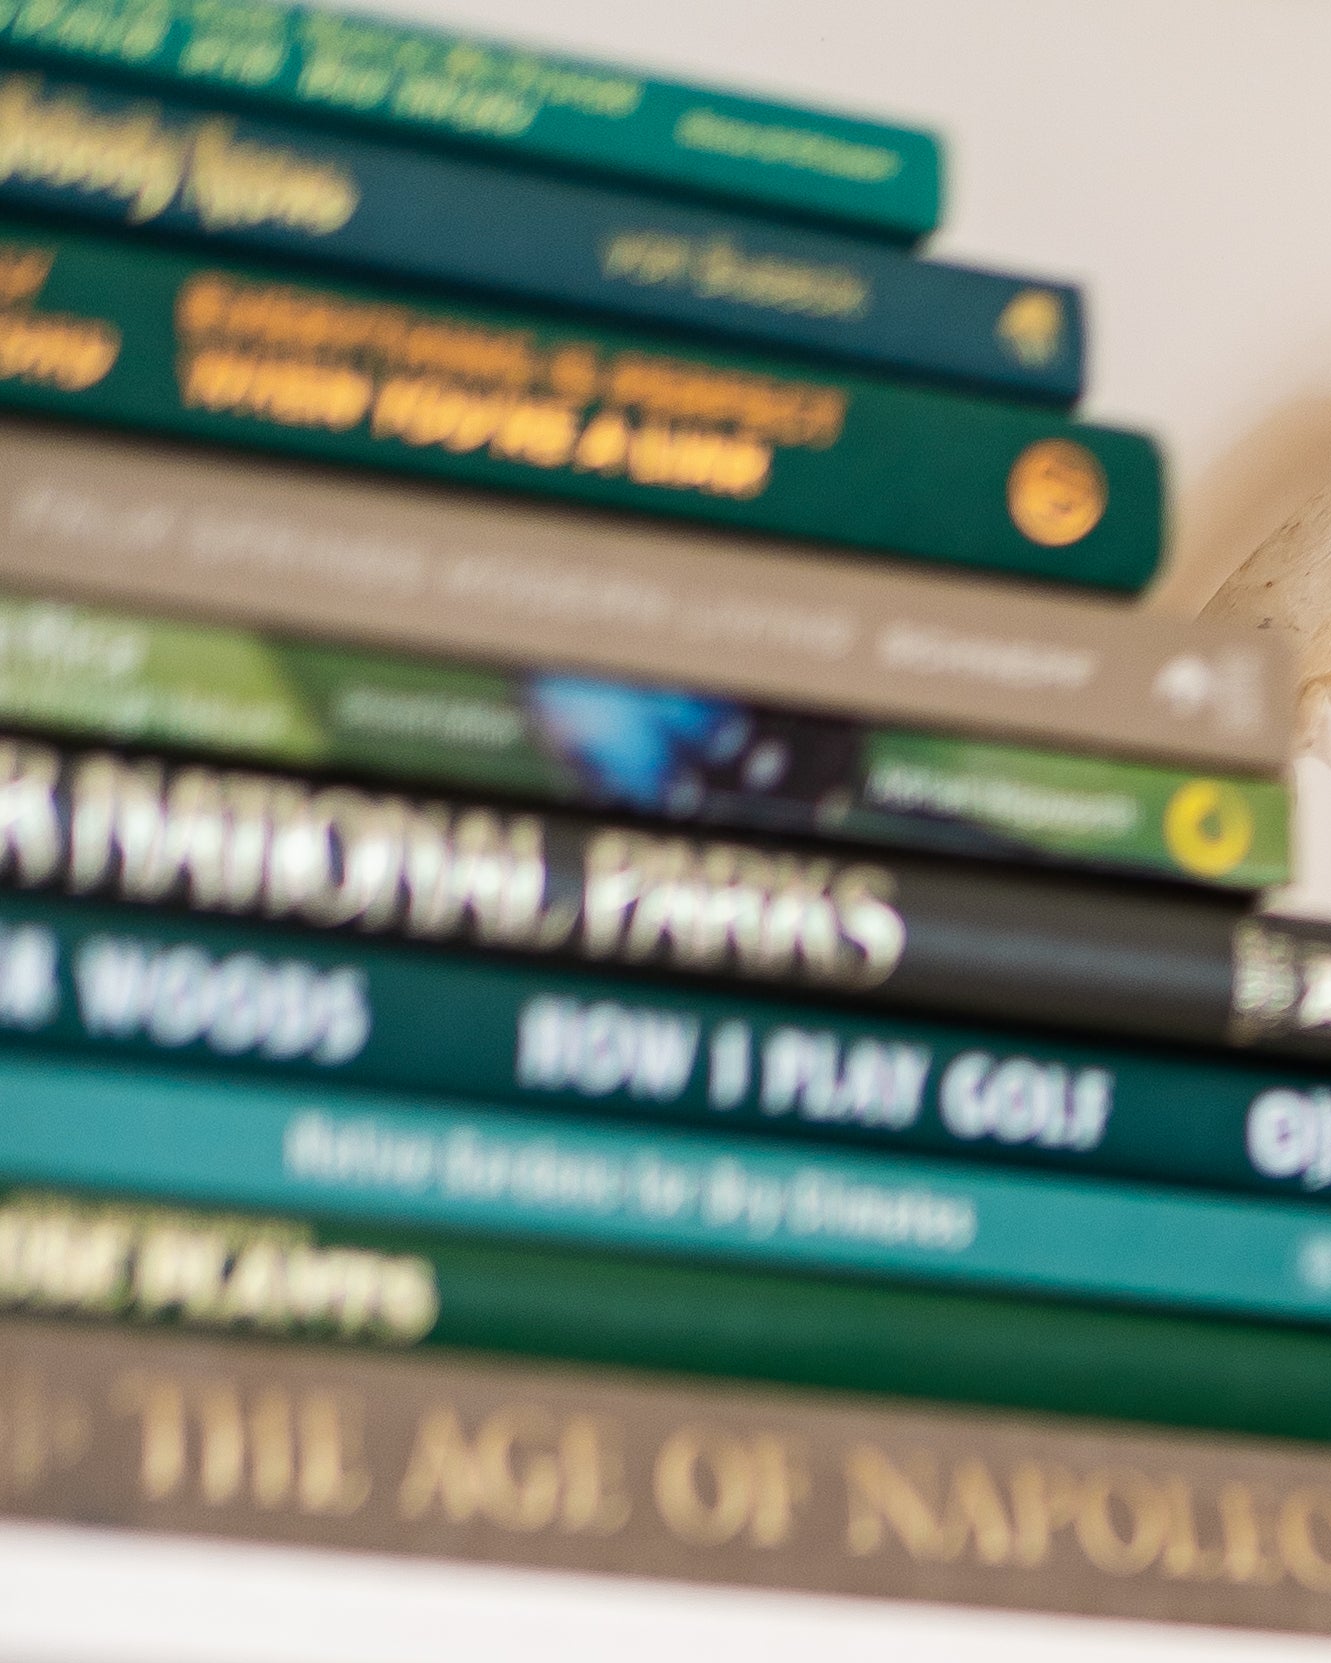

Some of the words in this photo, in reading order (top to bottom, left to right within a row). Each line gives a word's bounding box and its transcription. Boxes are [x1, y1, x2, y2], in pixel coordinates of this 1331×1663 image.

[68, 750, 578, 950] NATIONAL
[582, 825, 909, 992] PARKS
[72, 932, 372, 1066] WOODS
[515, 992, 697, 1098] HOW
[711, 1017, 750, 1112] I
[758, 1025, 933, 1134] PLAY
[938, 1048, 1115, 1153] GOLF
[118, 1372, 367, 1517] THE
[405, 1404, 631, 1537] AGE
[654, 1424, 814, 1550] OF
